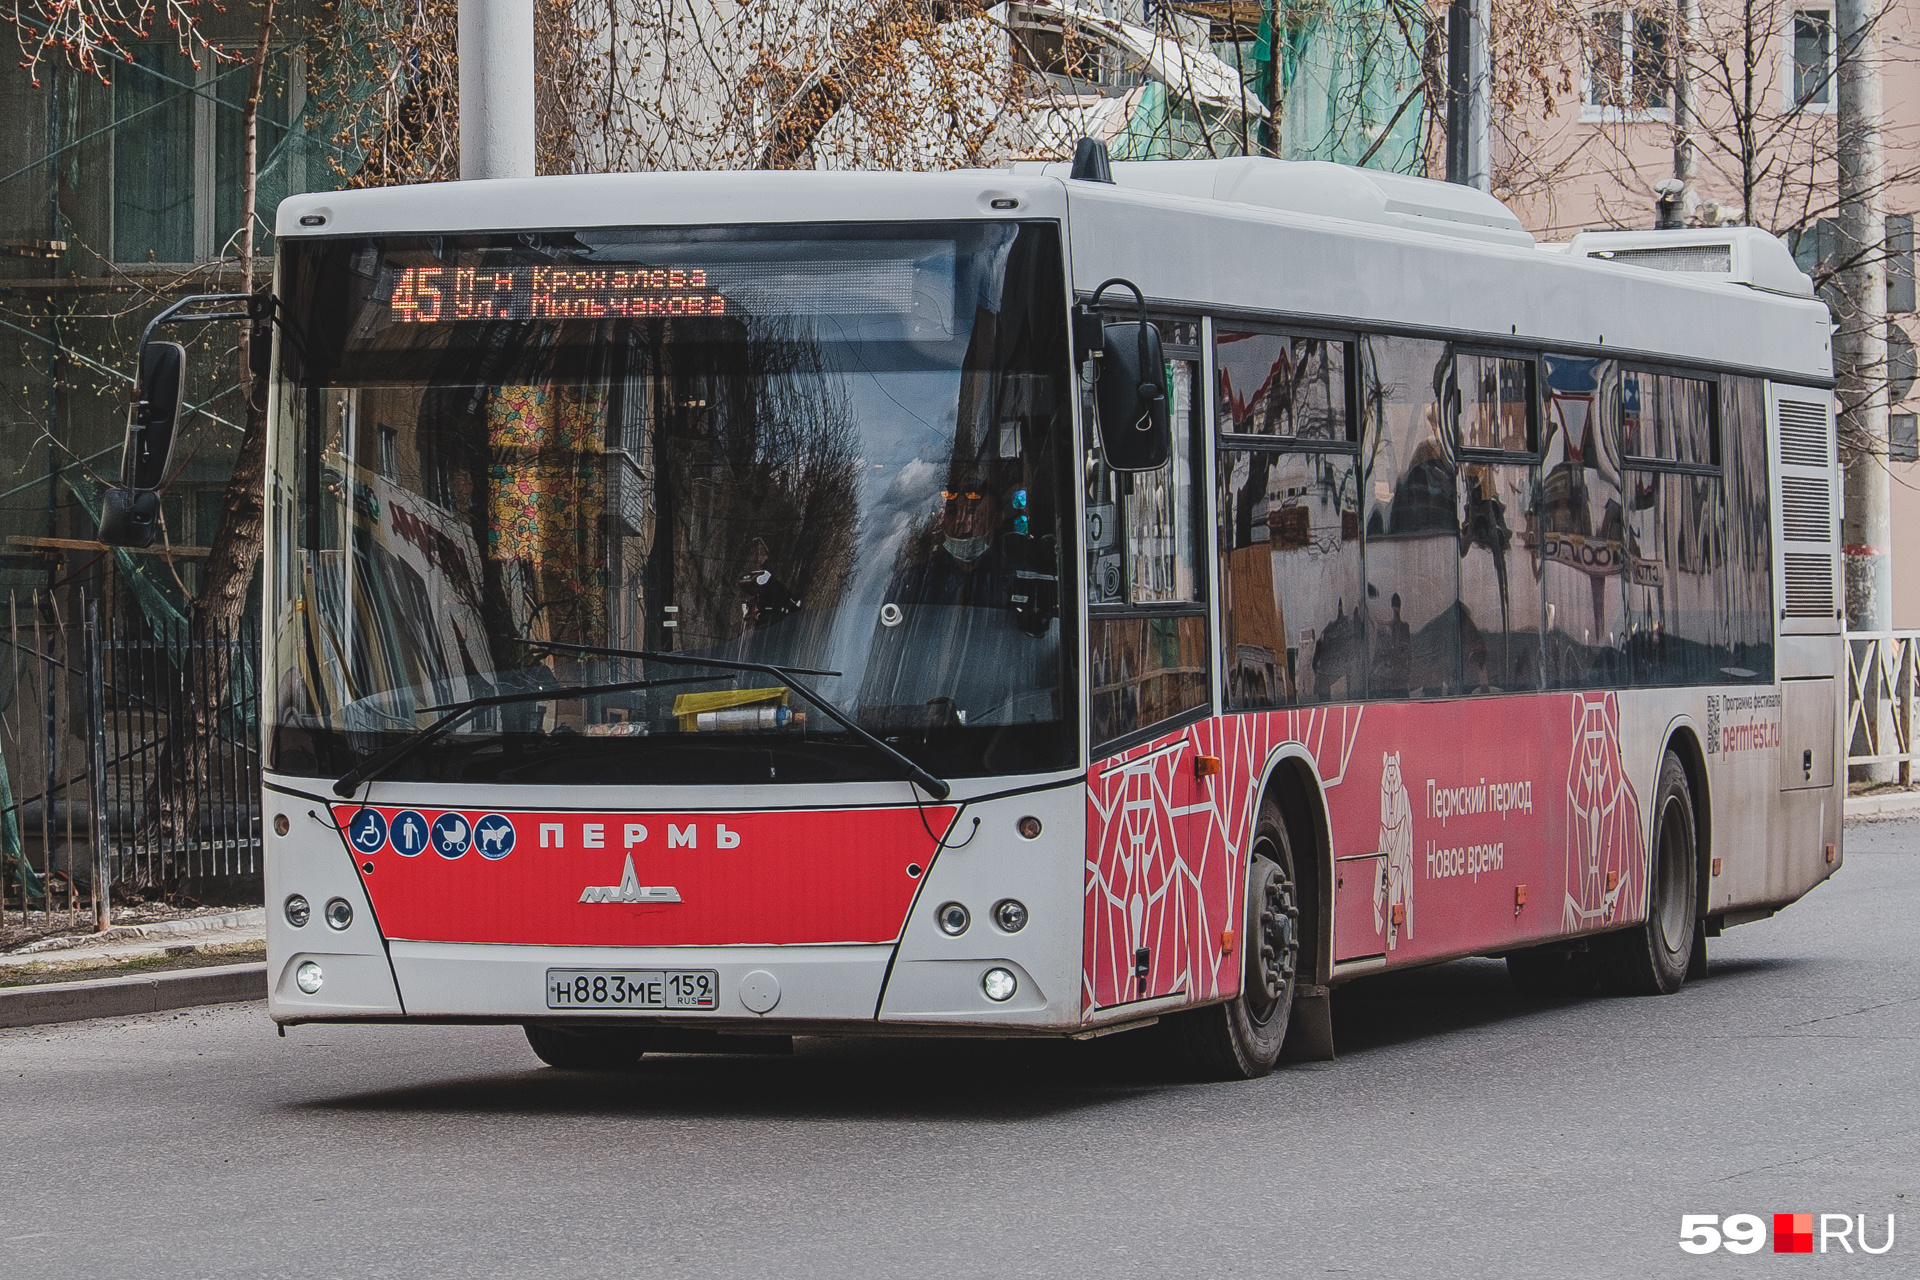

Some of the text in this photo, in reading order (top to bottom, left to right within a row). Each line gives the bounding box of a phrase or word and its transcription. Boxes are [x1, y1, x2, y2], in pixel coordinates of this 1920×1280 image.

[456, 266, 513, 291] М-н
[391, 267, 441, 322] 45
[455, 293, 725, 318] Ул. Мильчакова
[1723, 694, 1753, 716] Программа
[1722, 714, 1781, 762] permfest.ru
[1426, 777, 1533, 828] Пермский период
[539, 822, 742, 849] ПЕРМЬ
[1426, 839, 1505, 884] Новое время
[556, 974, 710, 1004] Н883МЕ 159
[677, 997, 698, 1005] RUS
